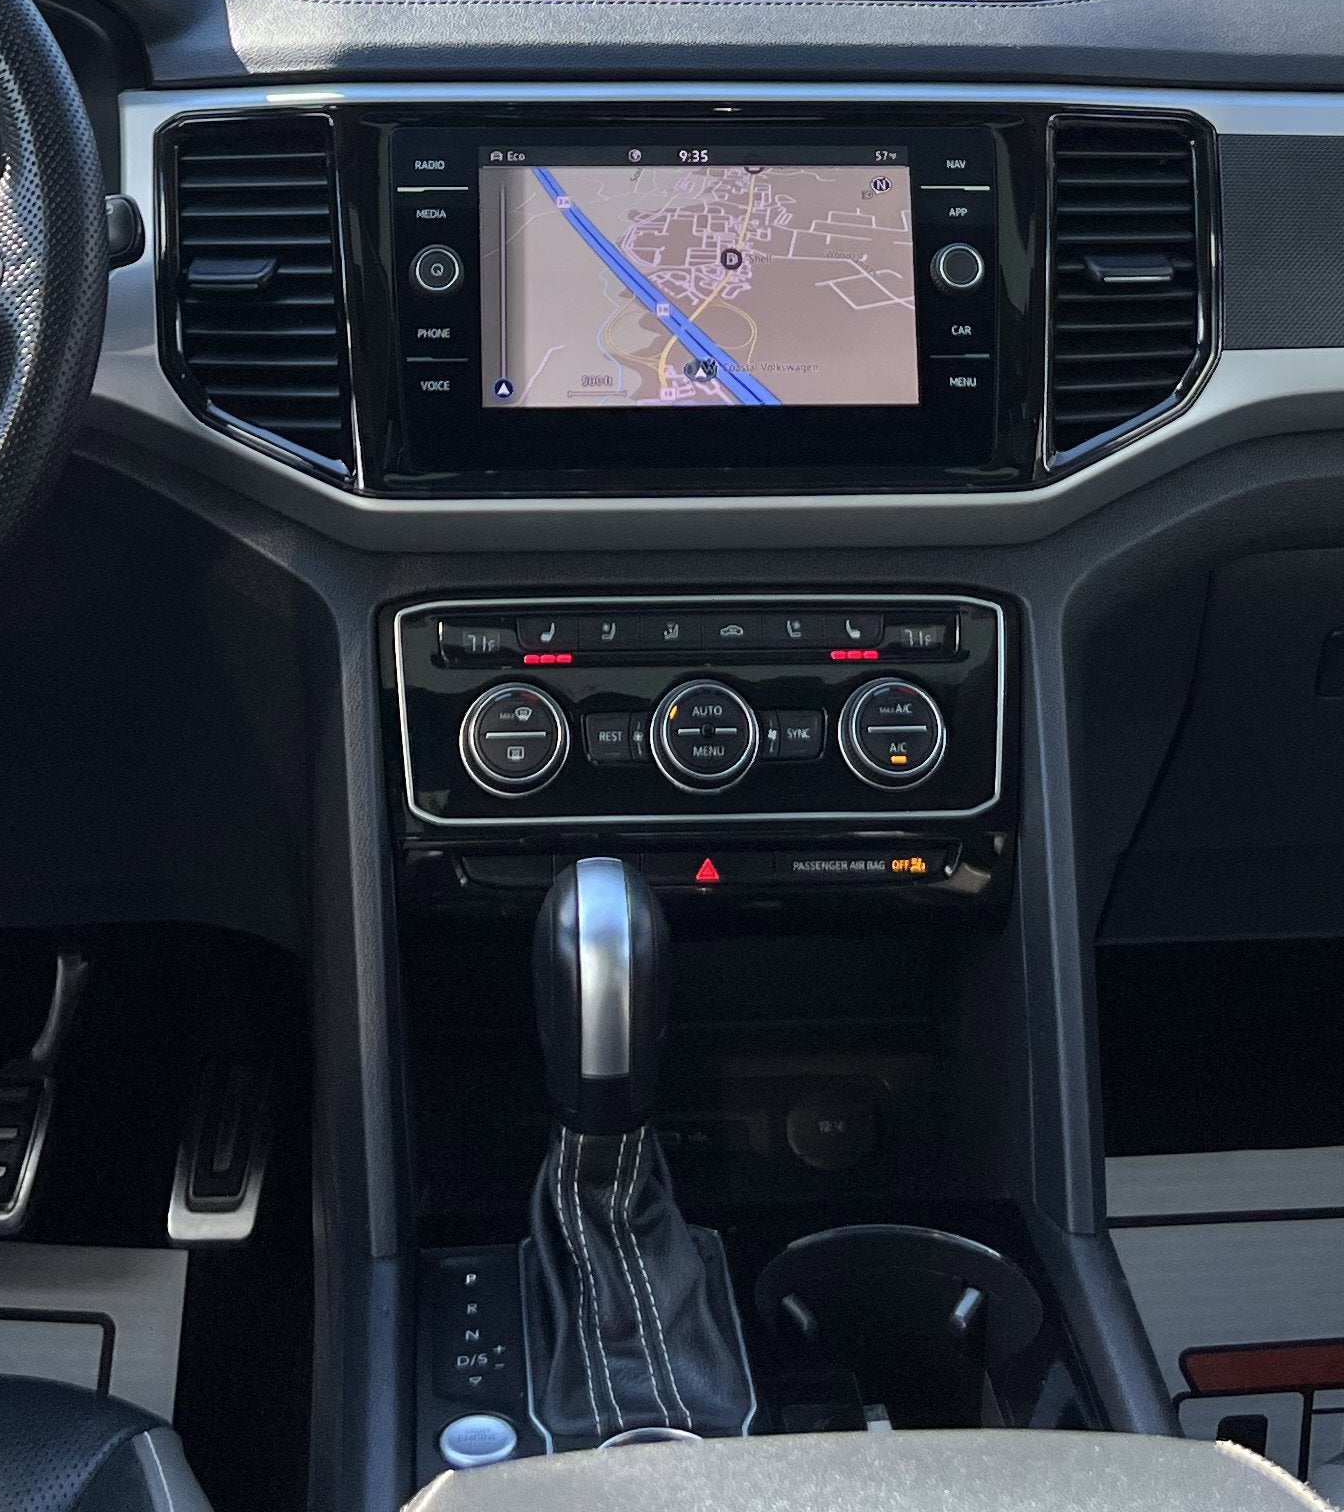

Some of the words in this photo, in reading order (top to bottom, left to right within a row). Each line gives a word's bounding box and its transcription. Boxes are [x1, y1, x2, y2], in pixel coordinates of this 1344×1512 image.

[506, 151, 526, 162] Eco
[678, 150, 709, 164] 9:35
[414, 159, 446, 171] RADIO
[945, 159, 967, 170] NAV
[876, 178, 887, 189] N
[416, 209, 447, 220] MEDIA
[948, 207, 968, 219] APP
[417, 327, 451, 339] PHONE
[951, 325, 972, 336] CAR
[761, 362, 819, 375] Volkswagen
[420, 380, 451, 391] VOICE
[949, 376, 978, 388] MENU
[691, 705, 723, 717] AUTO
[895, 703, 913, 714] A/C
[598, 730, 624, 742] REST
[787, 727, 811, 739] SYNC
[692, 745, 725, 757] MENU
[889, 741, 907, 753] A/C
[793, 860, 849, 871] PASSENGER
[850, 860, 866, 871] AIR
[868, 859, 886, 871] BAG
[891, 858, 910, 873] OFF
[465, 1273, 478, 1286] P
[466, 1302, 479, 1315] R
[465, 1328, 480, 1341] N
[457, 1353, 489, 1367] D/S
